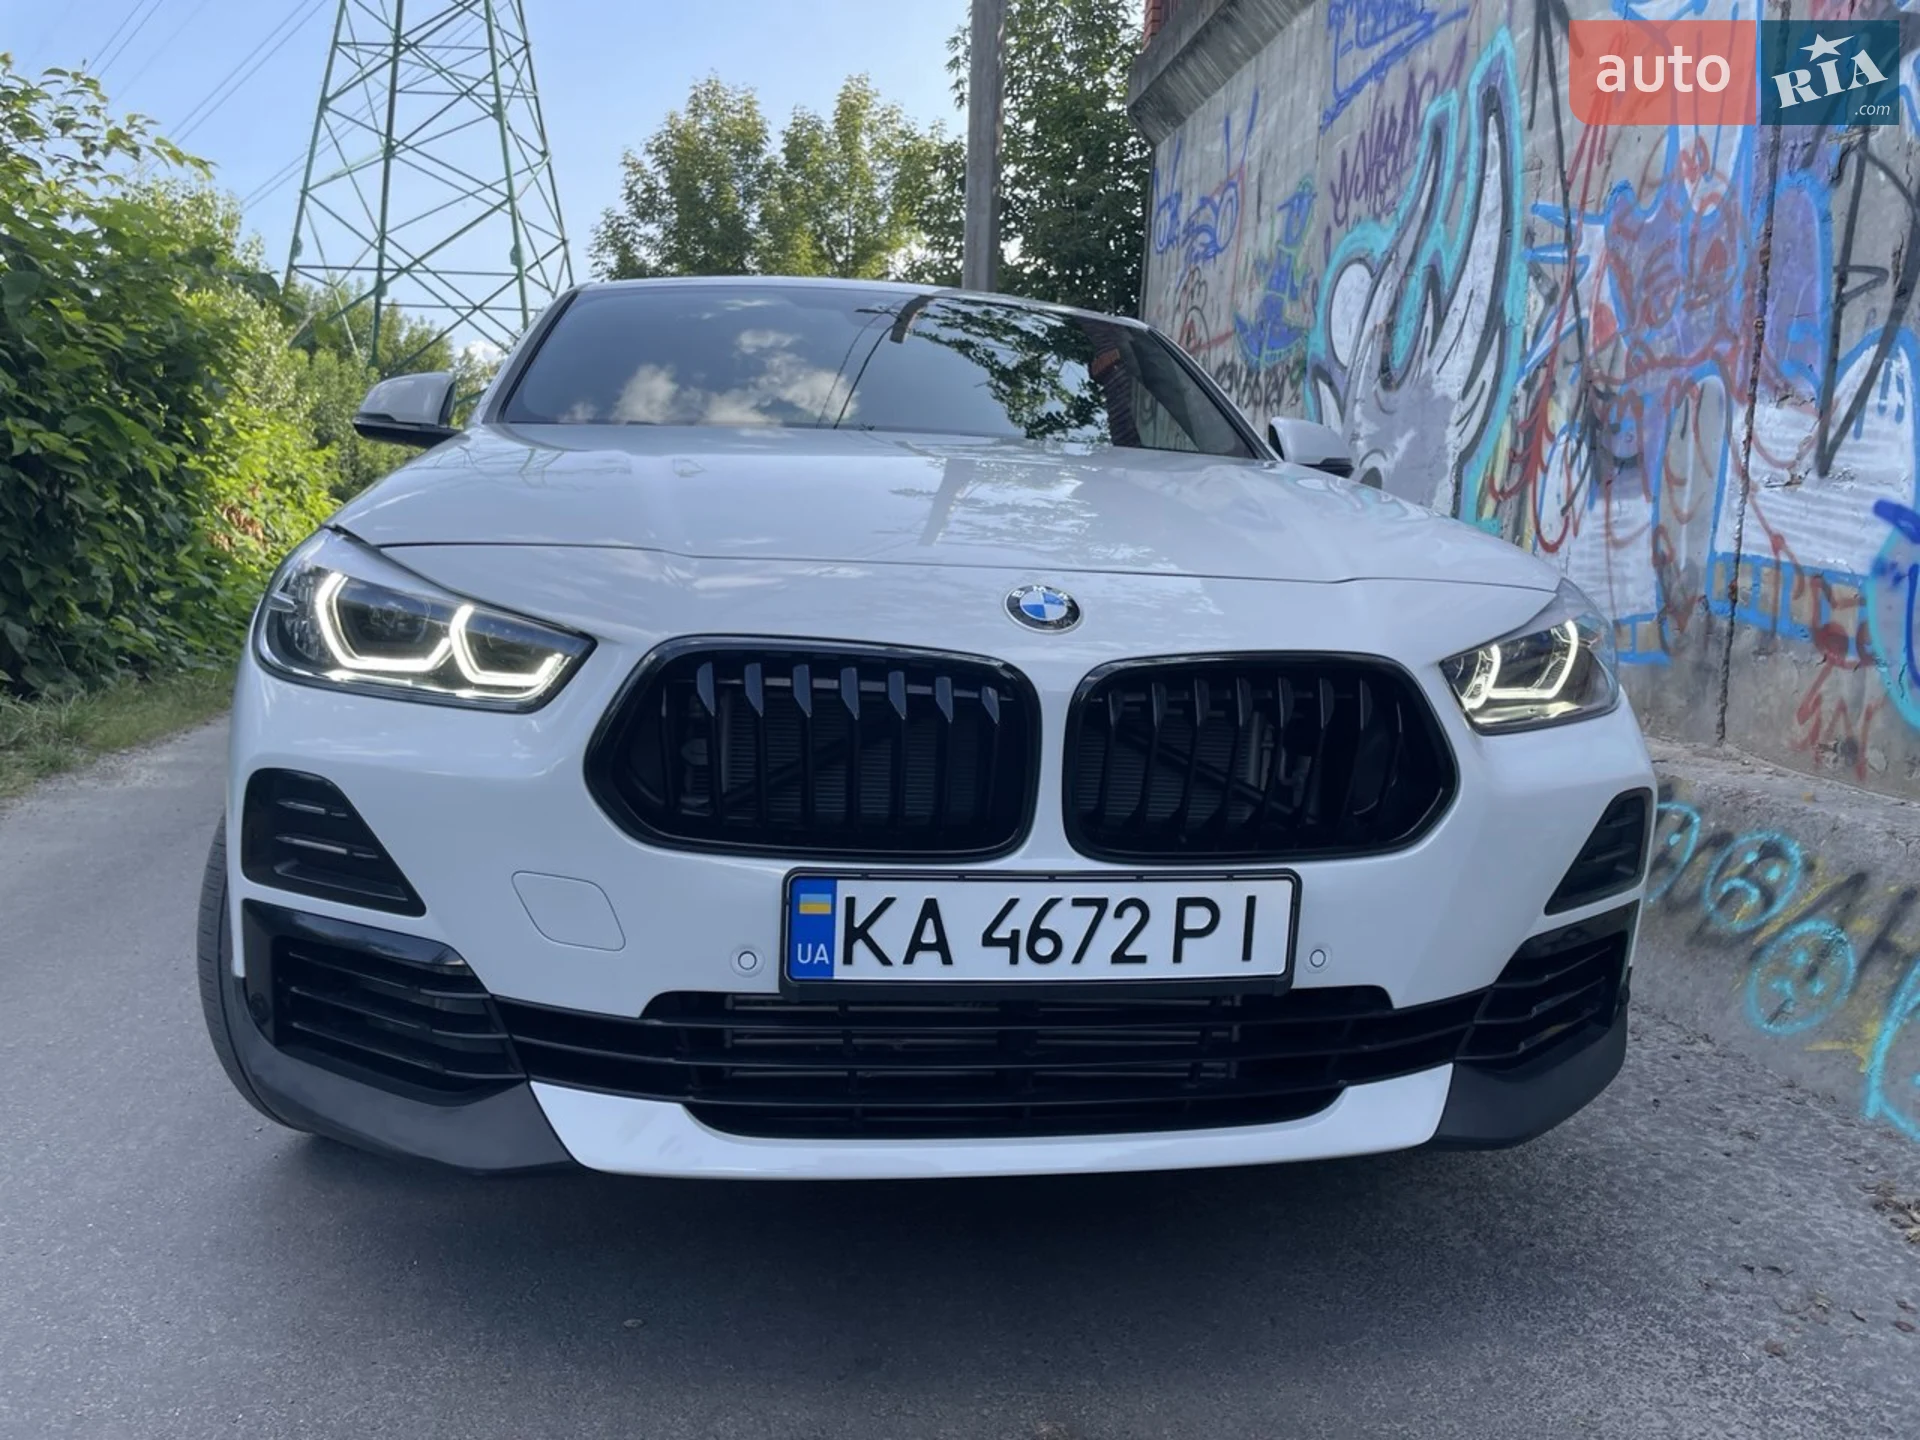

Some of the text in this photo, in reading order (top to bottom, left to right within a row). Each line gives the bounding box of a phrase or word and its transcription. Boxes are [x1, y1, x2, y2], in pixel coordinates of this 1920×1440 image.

[796, 943, 830, 965] UA
[841, 895, 1257, 967] KA 4672 PI
